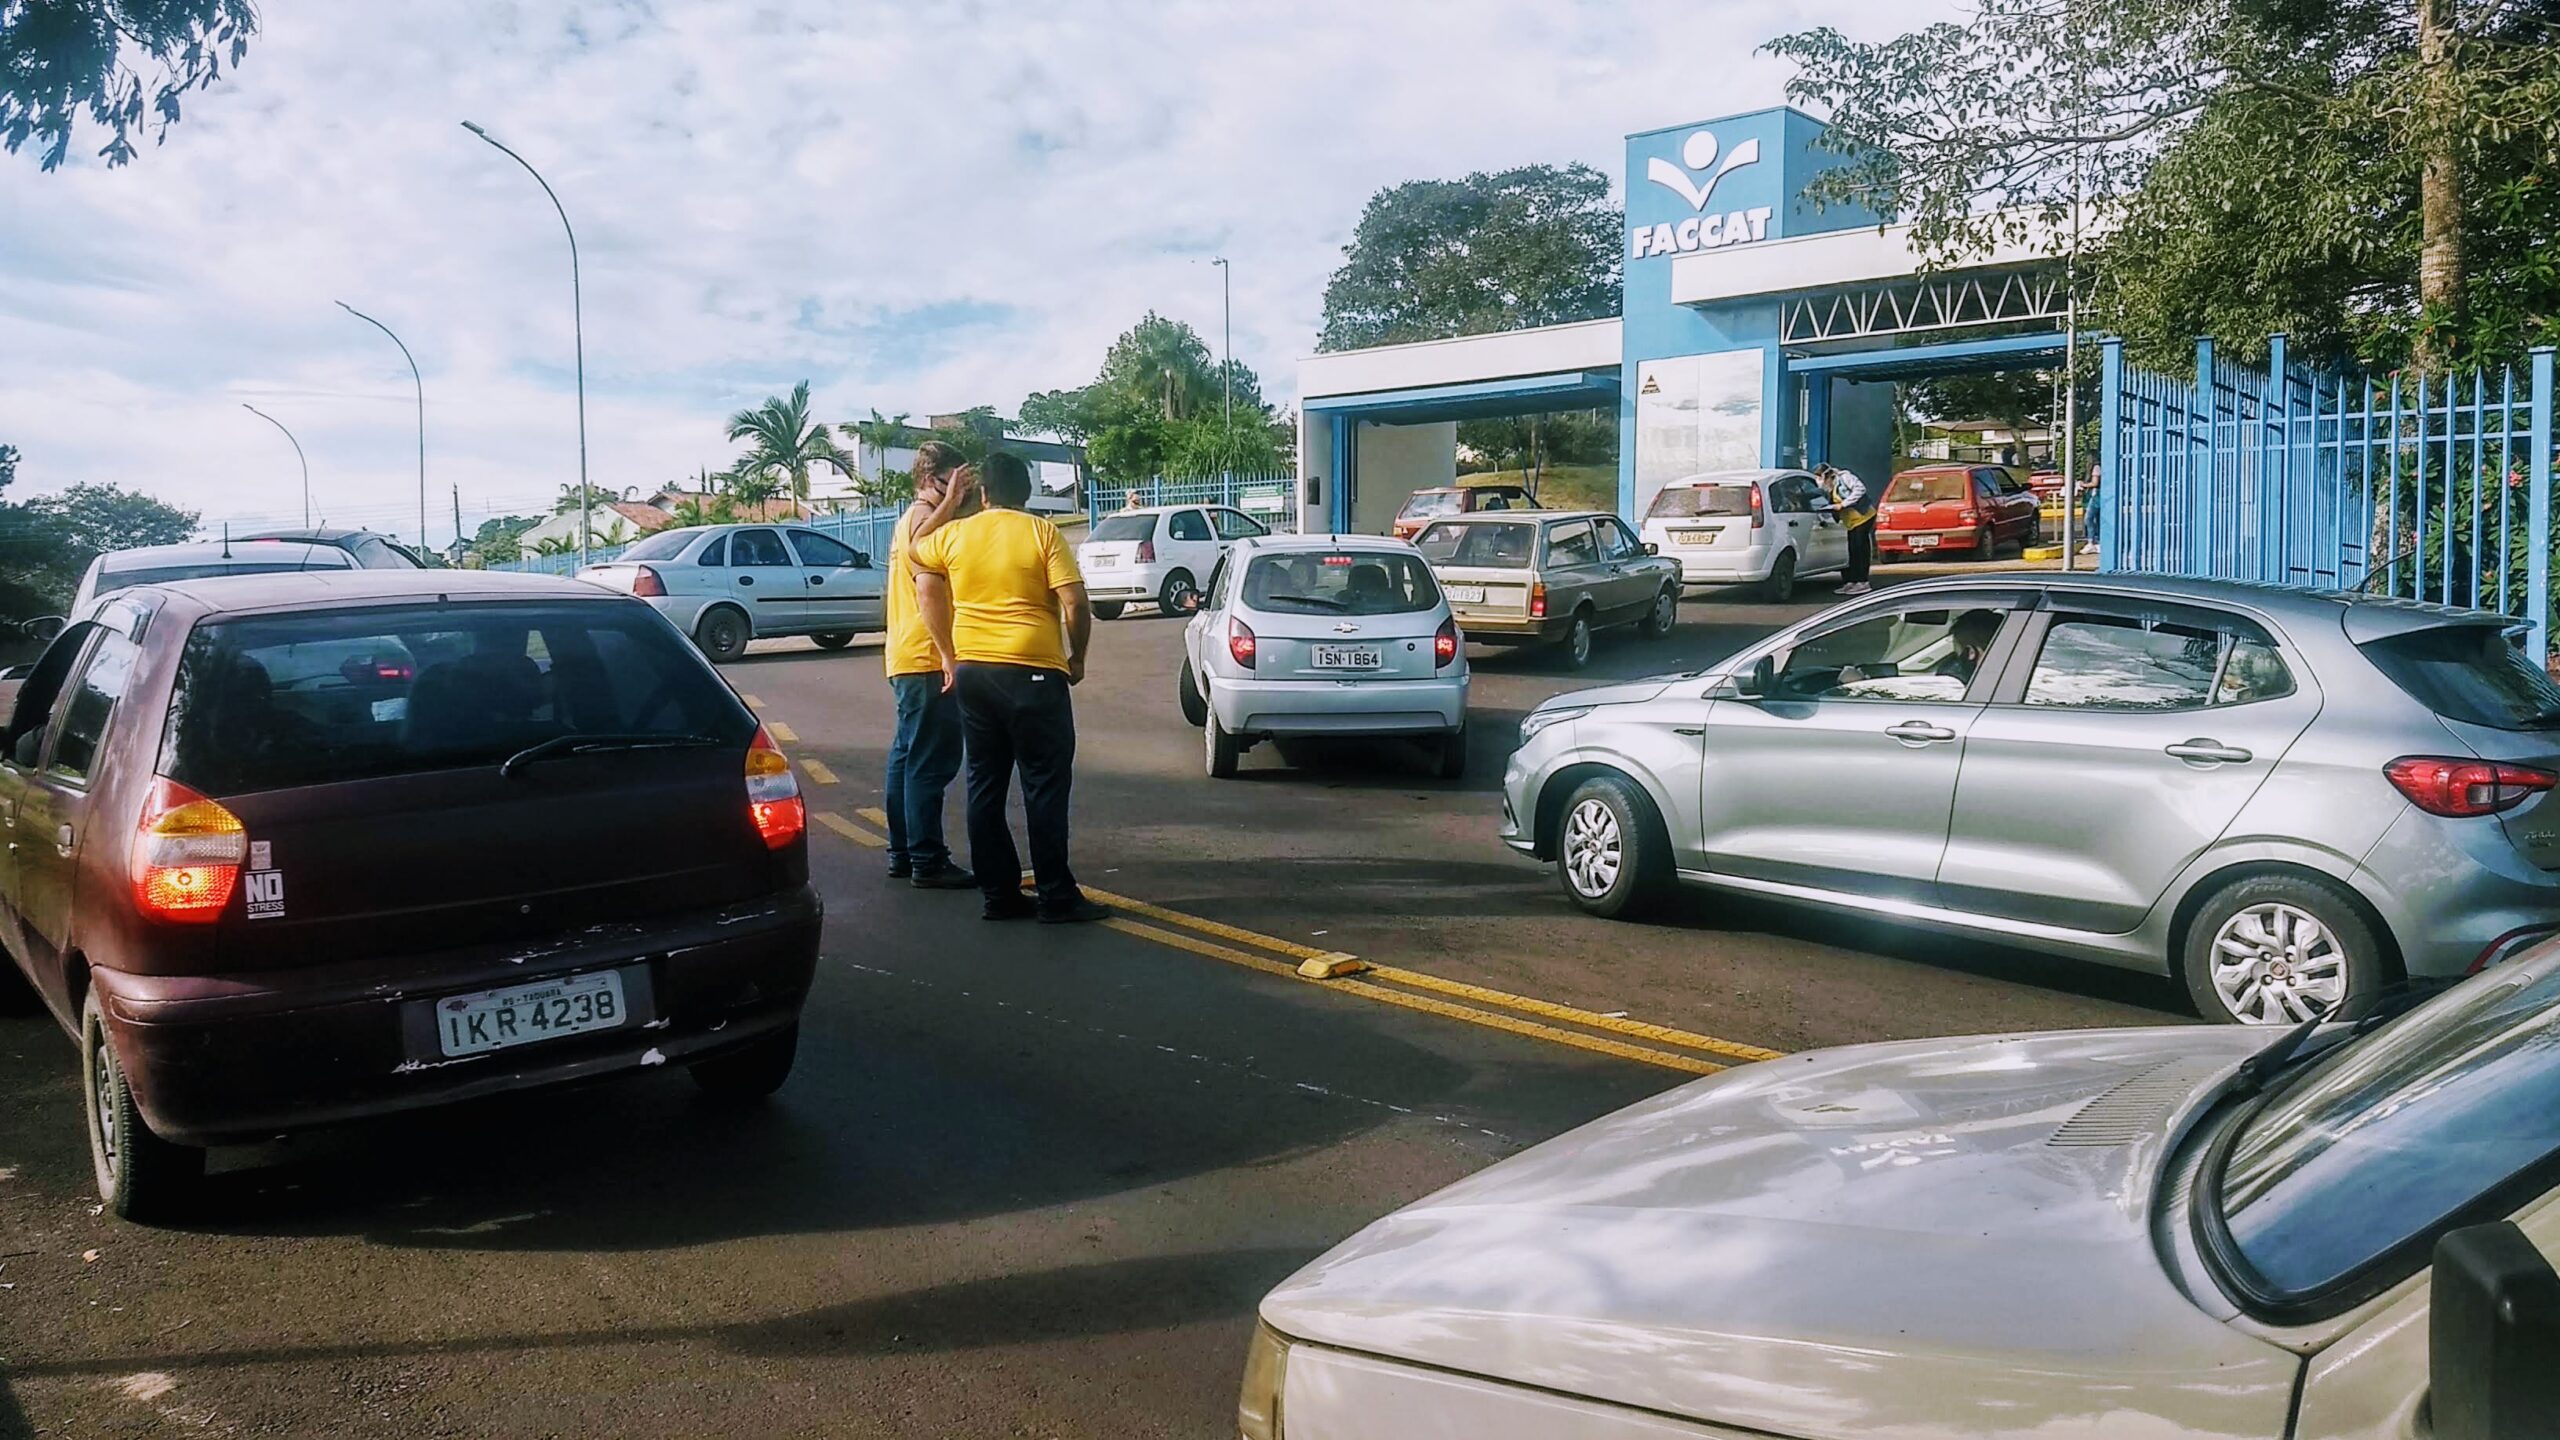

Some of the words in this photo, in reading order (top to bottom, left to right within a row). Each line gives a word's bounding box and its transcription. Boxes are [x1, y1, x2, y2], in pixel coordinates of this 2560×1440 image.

[1632, 206, 1772, 259] FACCAT
[245, 872, 284, 903] NO
[247, 901, 285, 913] STRESS
